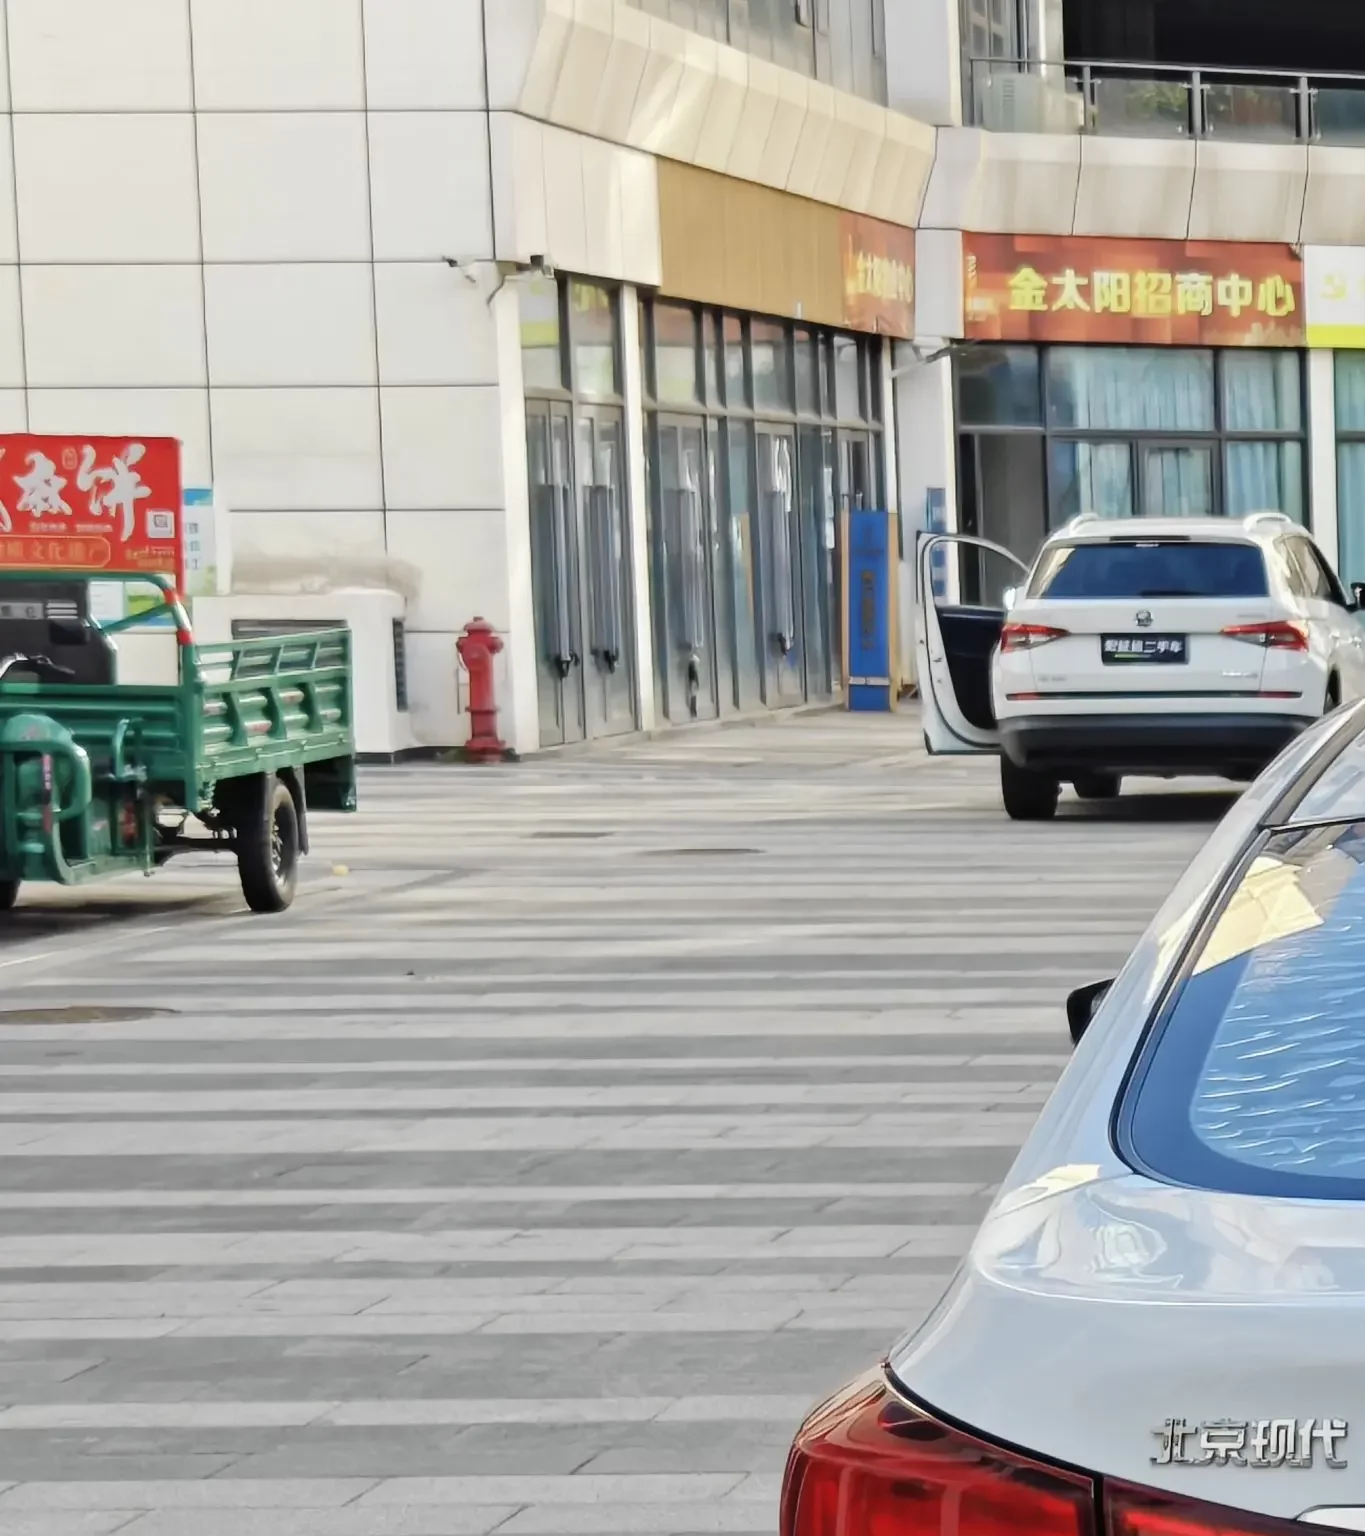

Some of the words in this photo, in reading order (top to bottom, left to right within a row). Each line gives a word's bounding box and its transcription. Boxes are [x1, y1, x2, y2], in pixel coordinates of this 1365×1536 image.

[1007, 266, 1297, 318] 金太阳招商中心
[0, 442, 153, 543] 麻饼
[1149, 1416, 1350, 1470] 北京现代
